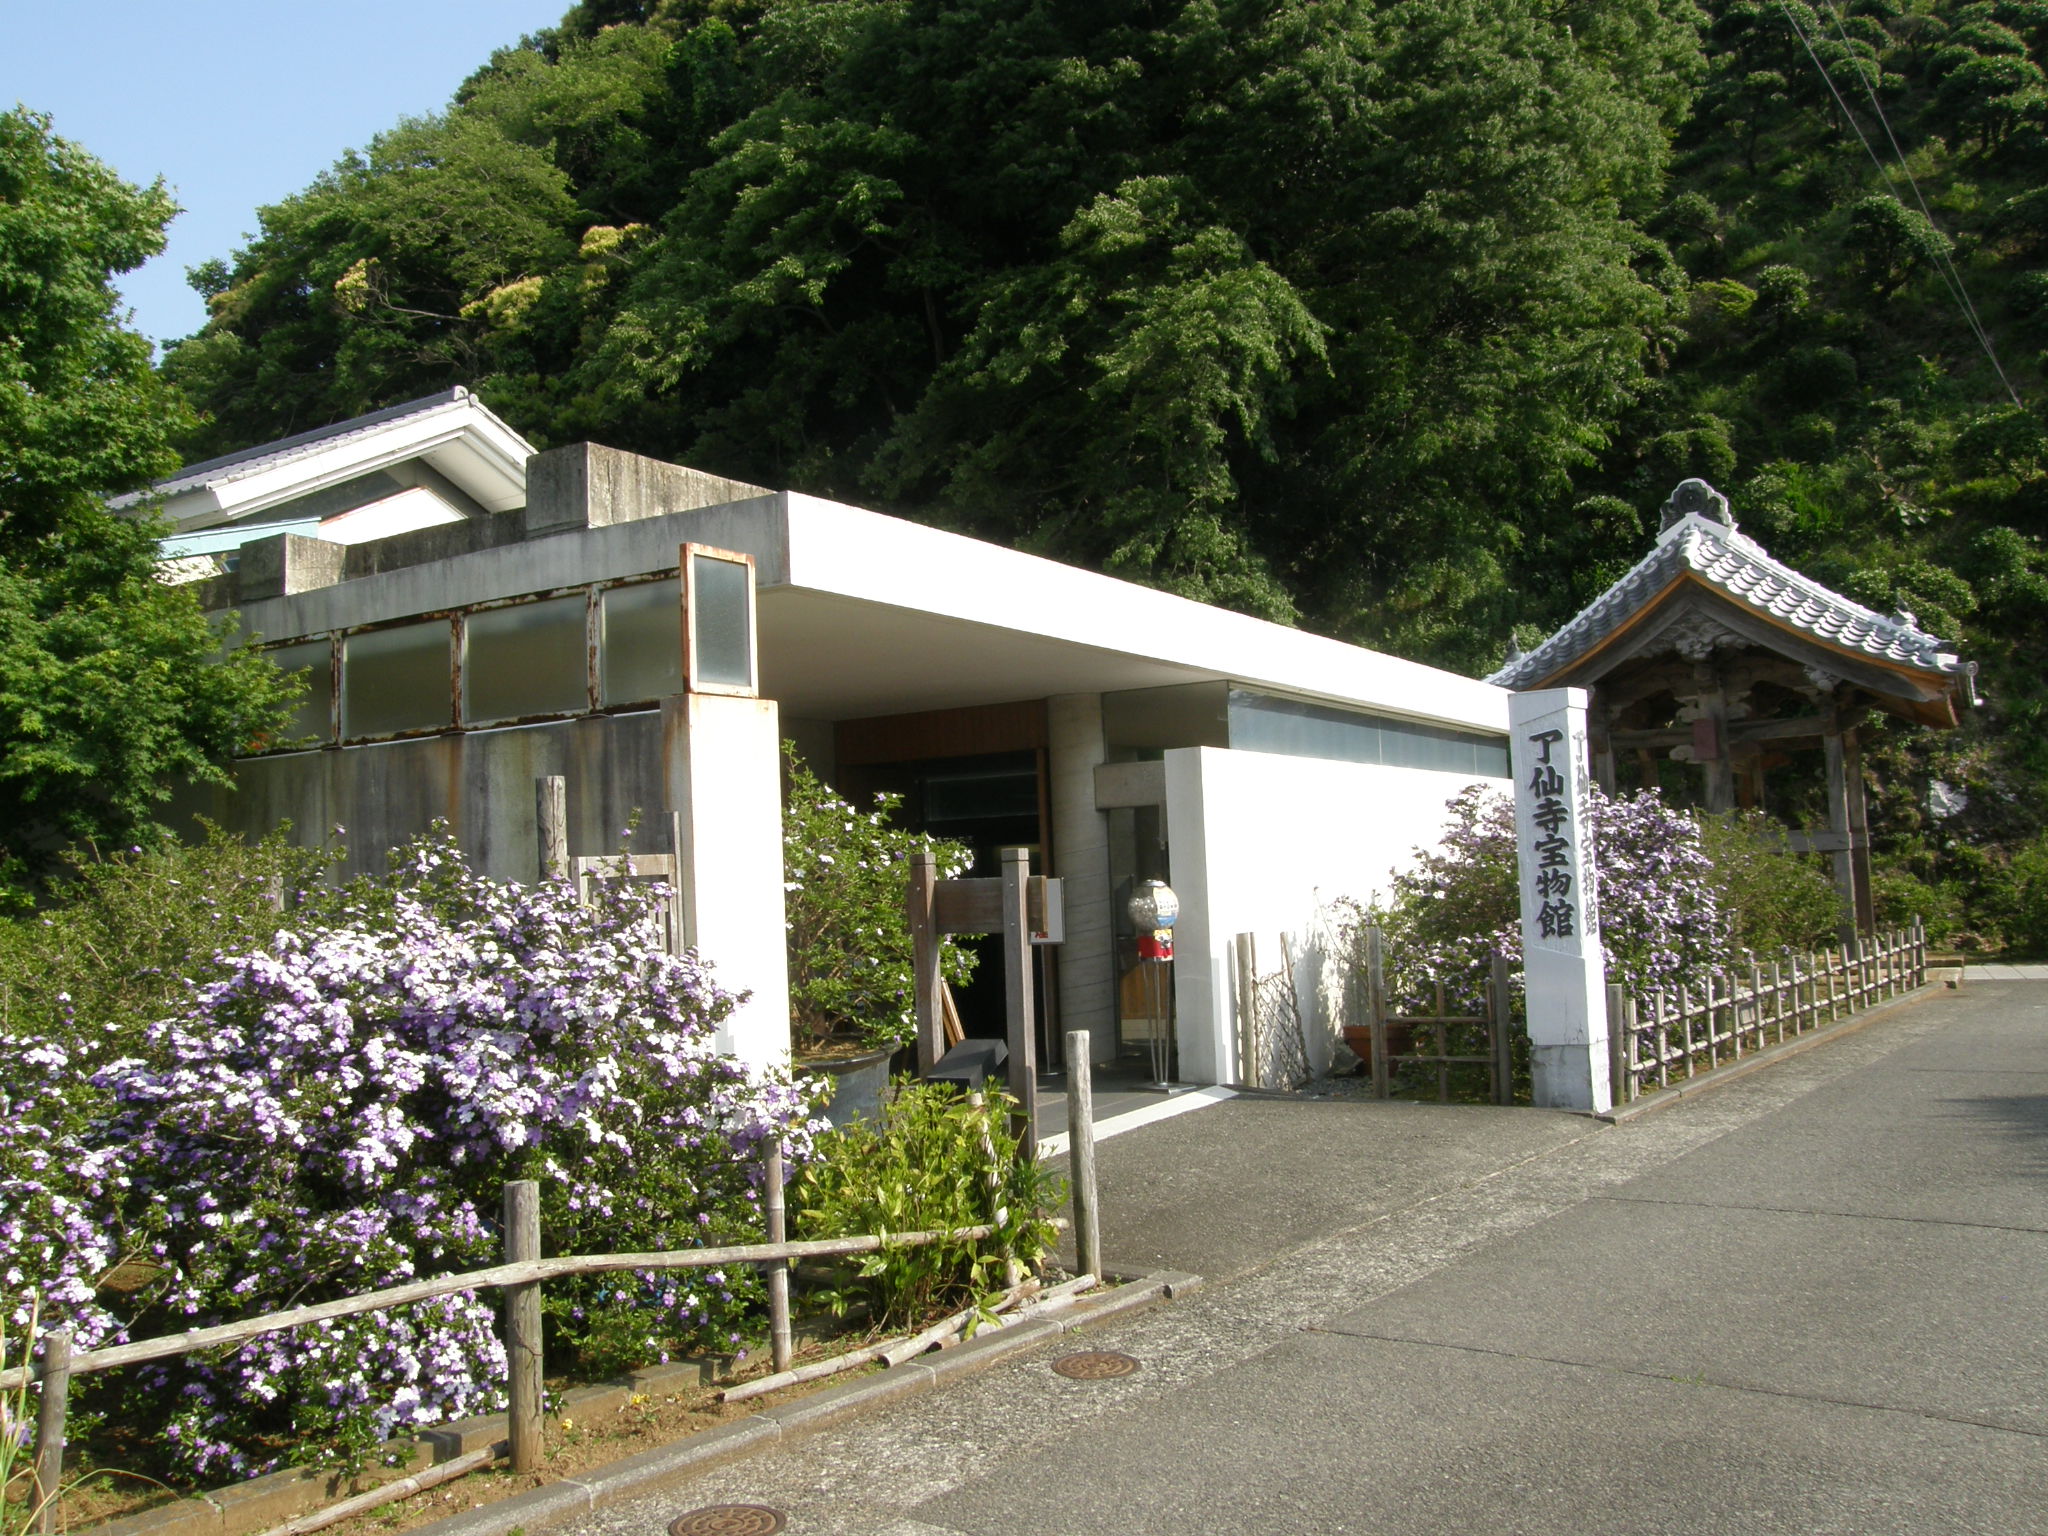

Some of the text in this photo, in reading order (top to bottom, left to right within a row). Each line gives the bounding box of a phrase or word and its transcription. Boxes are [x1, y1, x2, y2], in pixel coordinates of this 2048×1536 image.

[1528, 728, 1575, 939] 了仙寺宝物館
